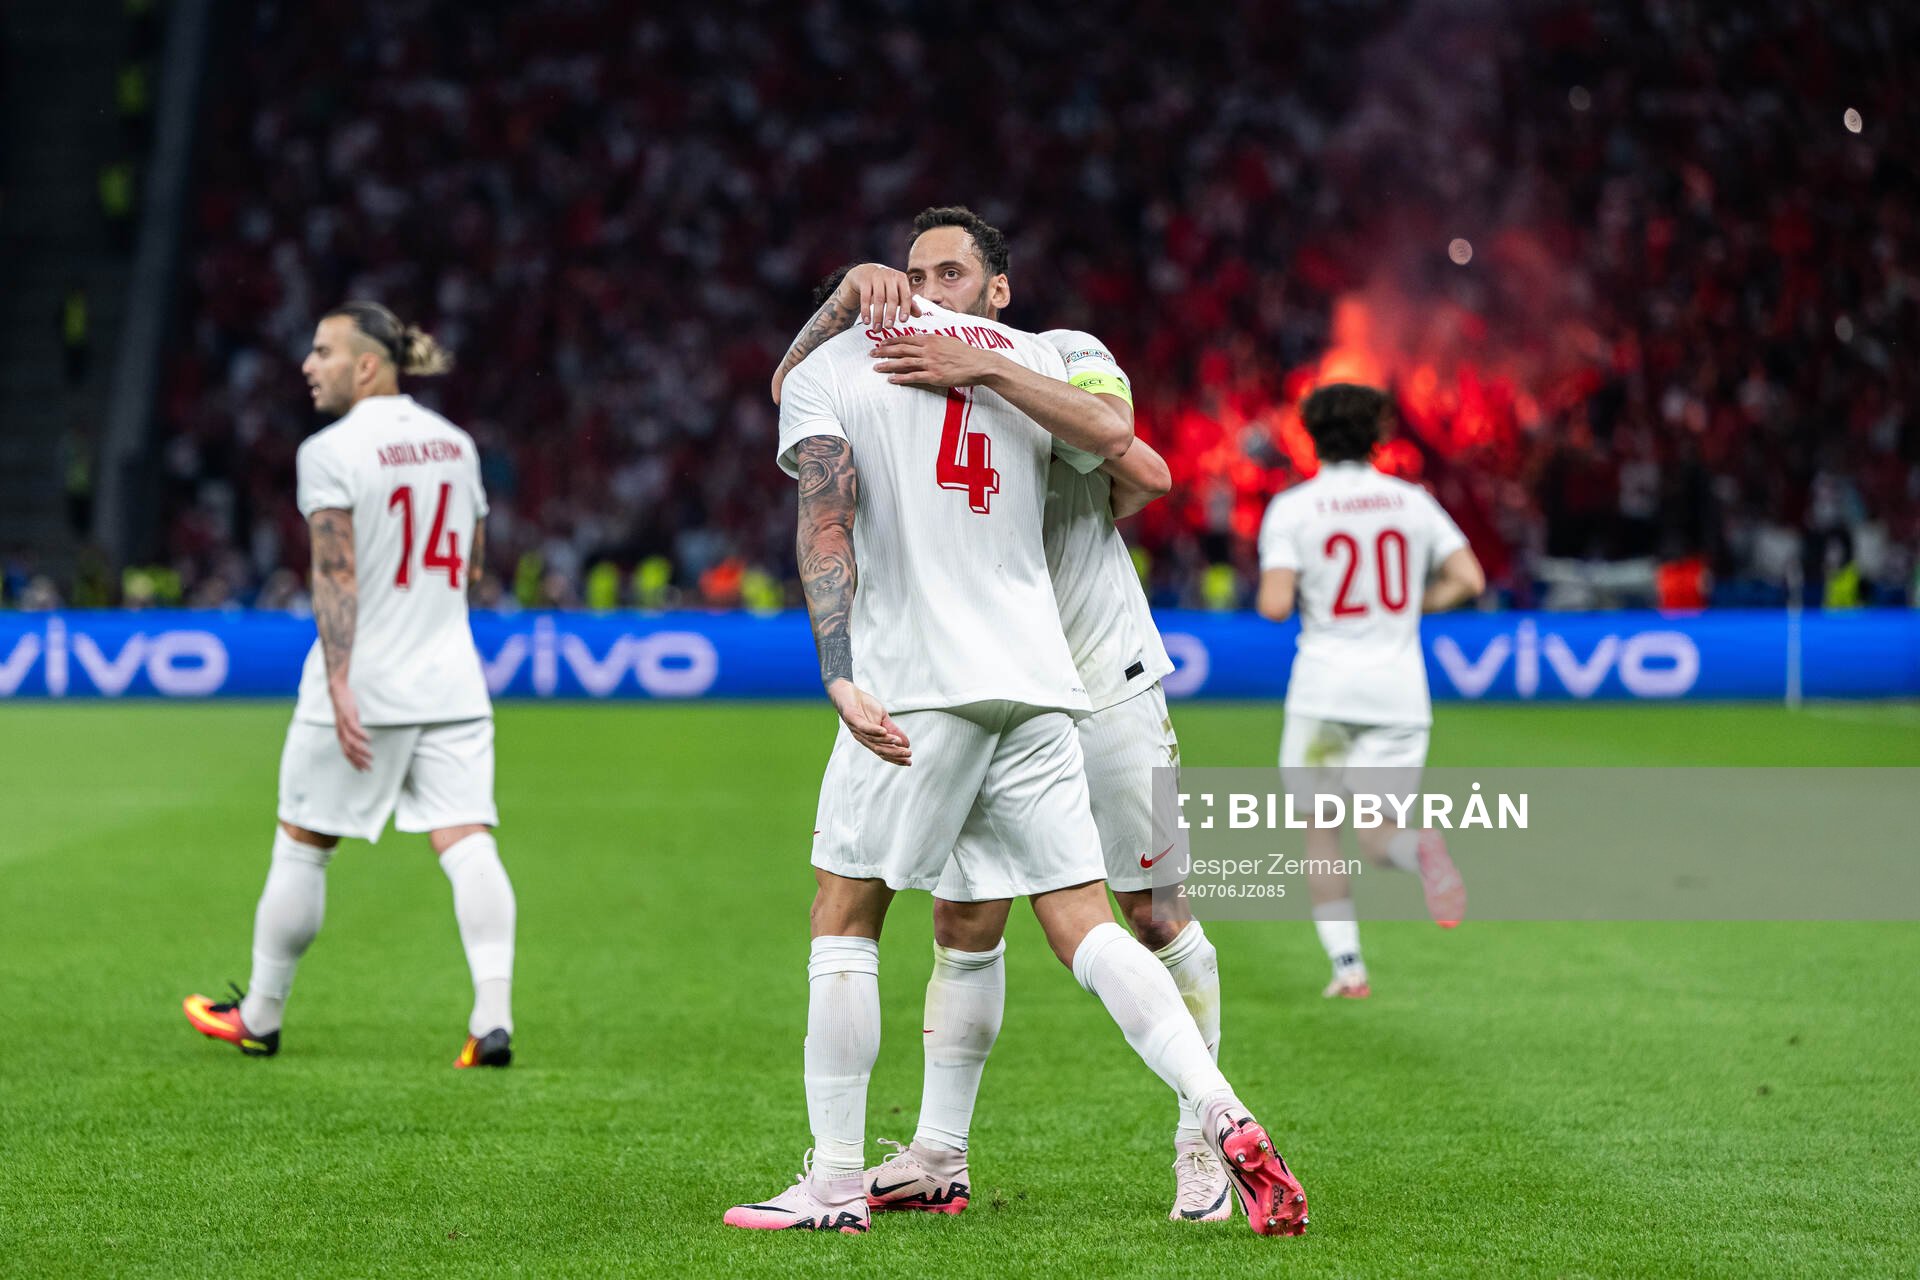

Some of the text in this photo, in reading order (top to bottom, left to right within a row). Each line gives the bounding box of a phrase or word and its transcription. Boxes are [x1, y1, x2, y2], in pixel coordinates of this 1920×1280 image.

[936, 385, 999, 514] 4
[388, 481, 463, 590] 14
[1323, 528, 1408, 617] 20
[1433, 617, 1701, 698] vivo
